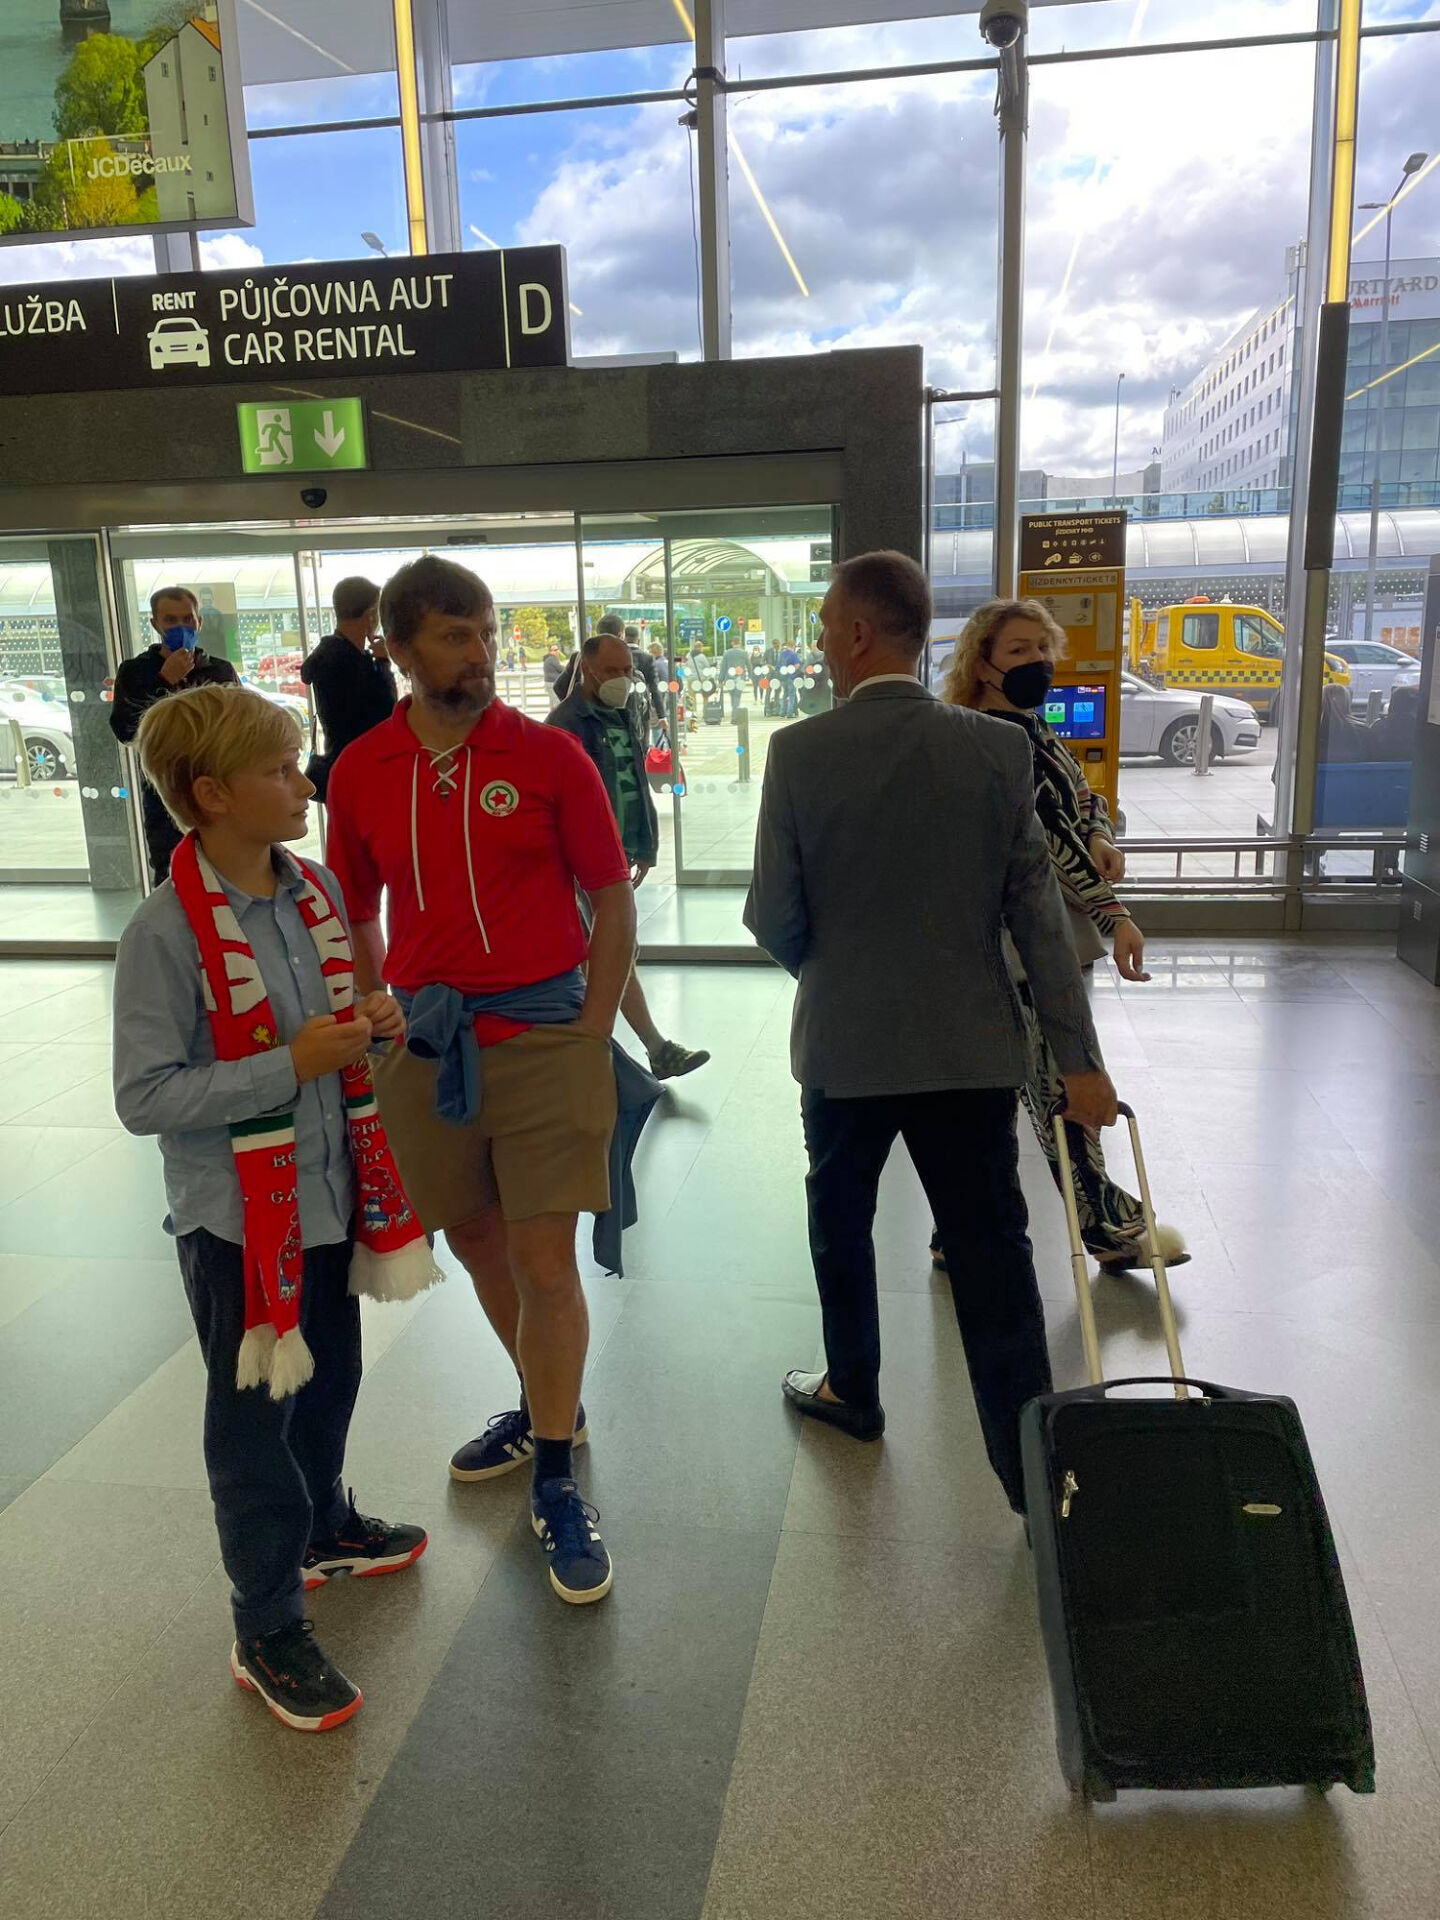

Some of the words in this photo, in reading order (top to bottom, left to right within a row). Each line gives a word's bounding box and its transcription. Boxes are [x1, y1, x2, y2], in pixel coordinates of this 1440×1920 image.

[87, 154, 193, 179] JCDecaux
[151, 291, 197, 311] RENT
[389, 274, 454, 311] AUT
[519, 282, 552, 335] D
[224, 331, 286, 366] CAR
[294, 323, 416, 362] RENTAL
[1054, 518, 1093, 527] TRANSPORT
